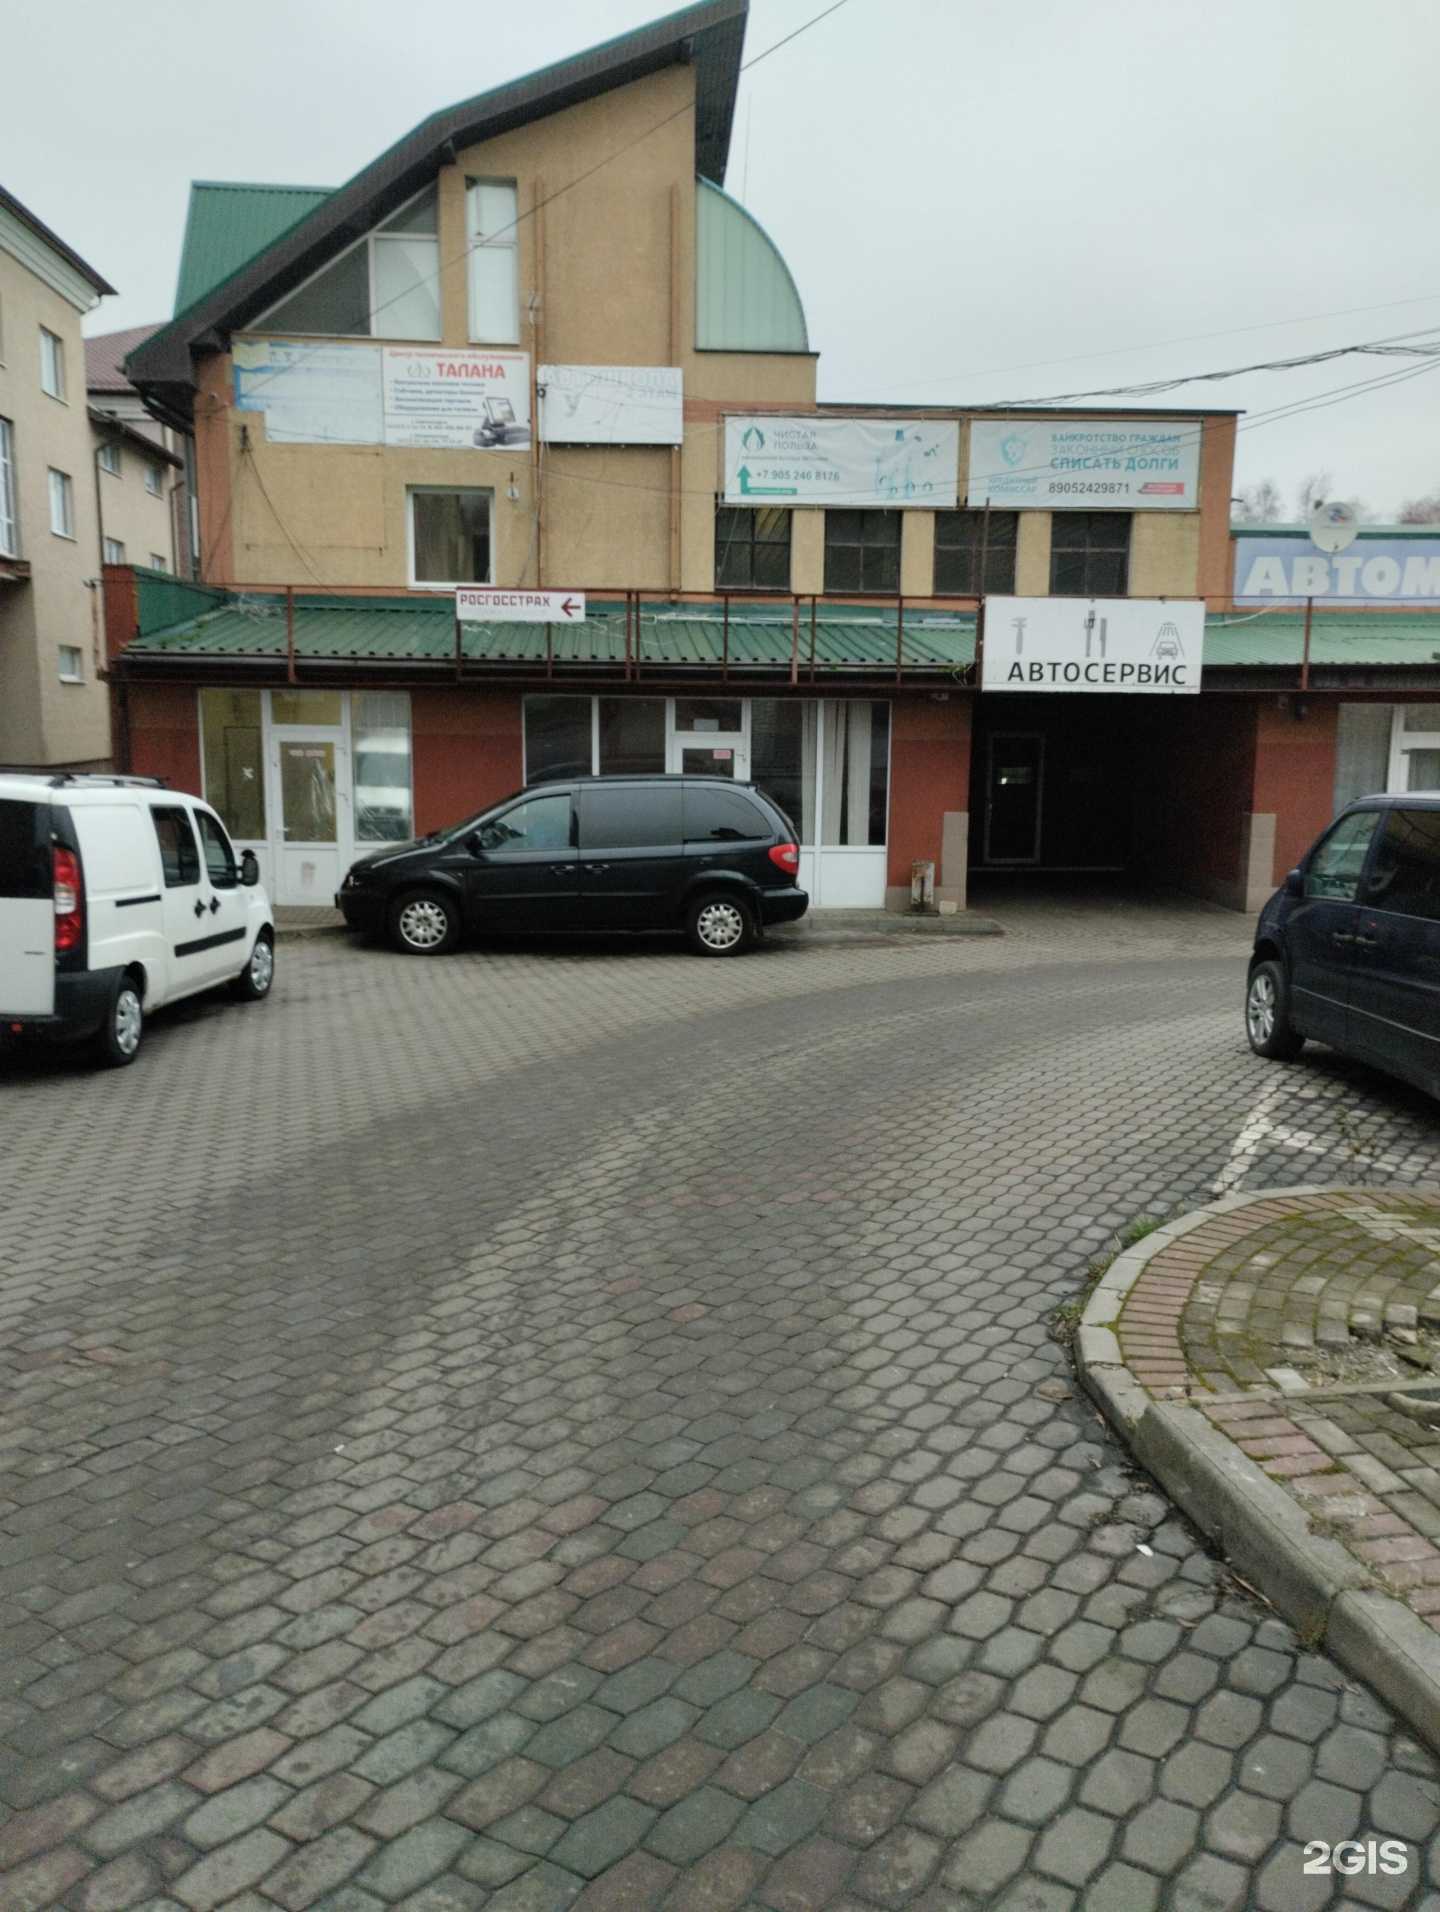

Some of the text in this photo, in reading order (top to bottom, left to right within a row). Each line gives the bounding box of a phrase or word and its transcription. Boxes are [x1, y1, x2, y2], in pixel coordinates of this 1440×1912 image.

[1051, 432, 1127, 442] БАНКРОТСТВО
[1050, 457, 1179, 472] СПИСАТЬ ДОЛГИ
[1048, 482, 1130, 494] 89052429871
[1242, 556, 1440, 595] АВТОМ
[460, 594, 551, 607] РОСГОССТРАХ
[1007, 661, 1188, 685] АВТОСЕРВИС
